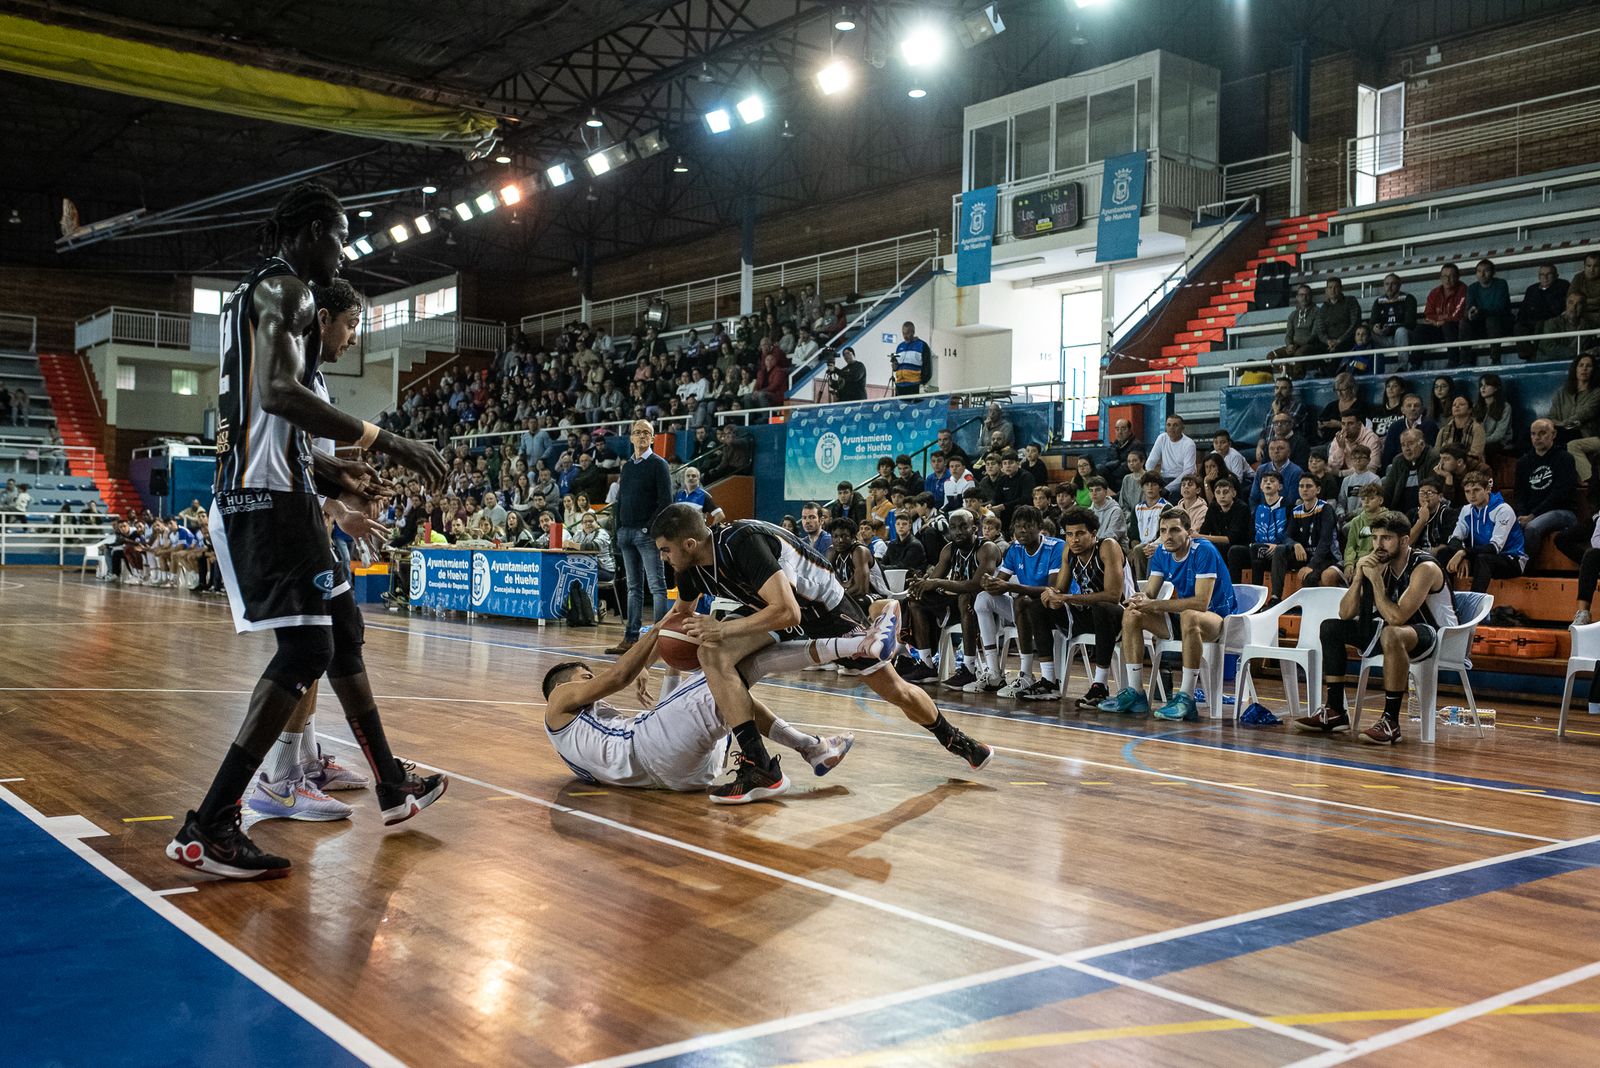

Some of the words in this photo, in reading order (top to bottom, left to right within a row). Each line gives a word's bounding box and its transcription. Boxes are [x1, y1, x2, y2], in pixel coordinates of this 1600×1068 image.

[944, 348, 957, 357] 114
[842, 434, 892, 445] Ayuntamiento
[856, 444, 866, 453] de
[867, 443, 892, 452] Huelva
[427, 557, 469, 569] Ayuntamiento
[491, 560, 539, 573] Ayuntamiento
[438, 569, 446, 579] de
[447, 570, 468, 581] Huelva
[504, 573, 513, 584] de
[514, 573, 539, 585] Huelva
[521, 587, 539, 595] Deportes
[1526, 582, 1538, 590] 52
